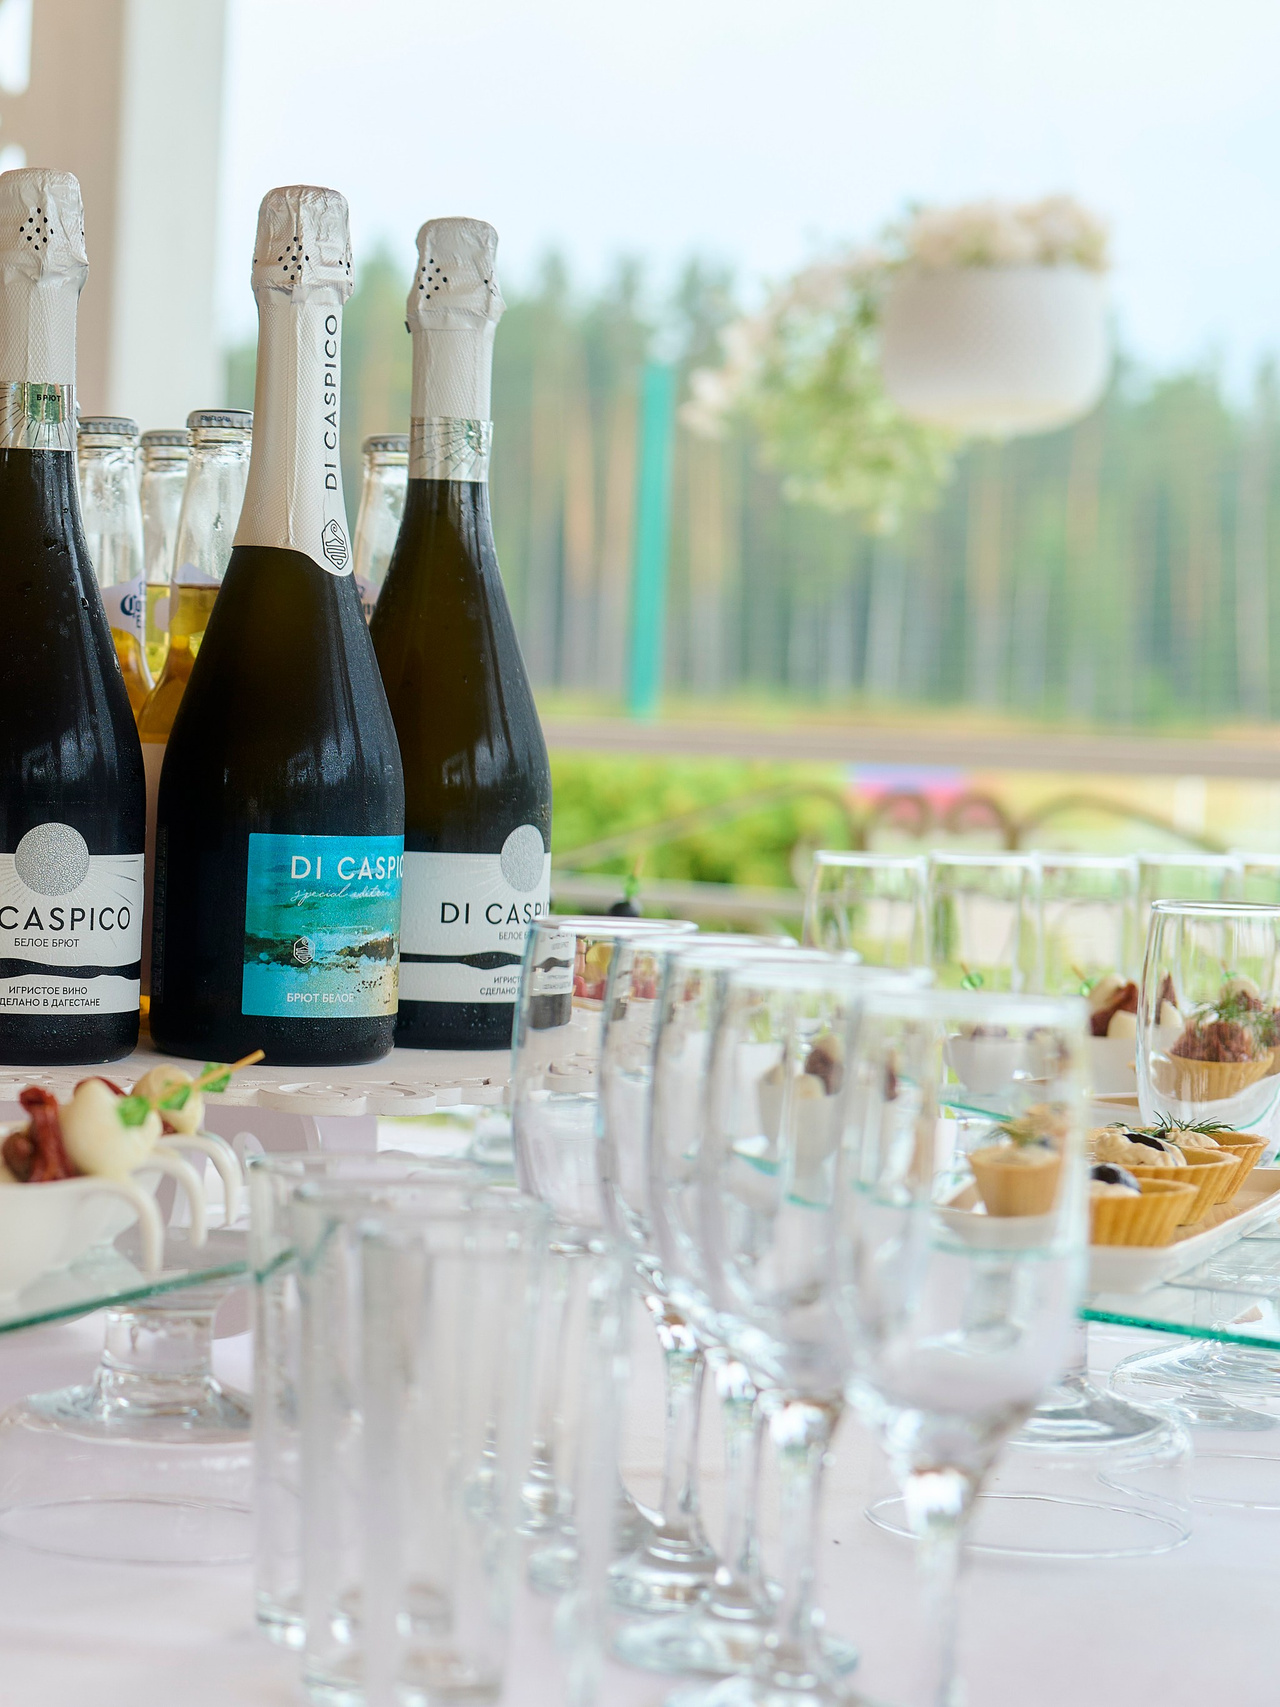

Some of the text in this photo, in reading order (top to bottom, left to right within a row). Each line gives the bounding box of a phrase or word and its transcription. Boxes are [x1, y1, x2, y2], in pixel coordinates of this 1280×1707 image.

[36, 394, 61, 402] БРЮТ
[324, 314, 338, 490] DI CASPICO
[291, 855, 322, 880] DI
[290, 883, 347, 907] special
[440, 902, 470, 925] DI
[499, 931, 523, 941] БЕЛОЕ
[14, 938, 80, 948] БЕЛОЕ БРЮТ
[8, 985, 88, 995] ИГРИСТОЕ ВИНО
[480, 987, 517, 996] СДЕЛАНО
[286, 992, 355, 1003] БРЮТ БЕЛОЕ
[42, 998, 49, 1007] В
[51, 998, 101, 1008] ДАГЕСТАНЕ
